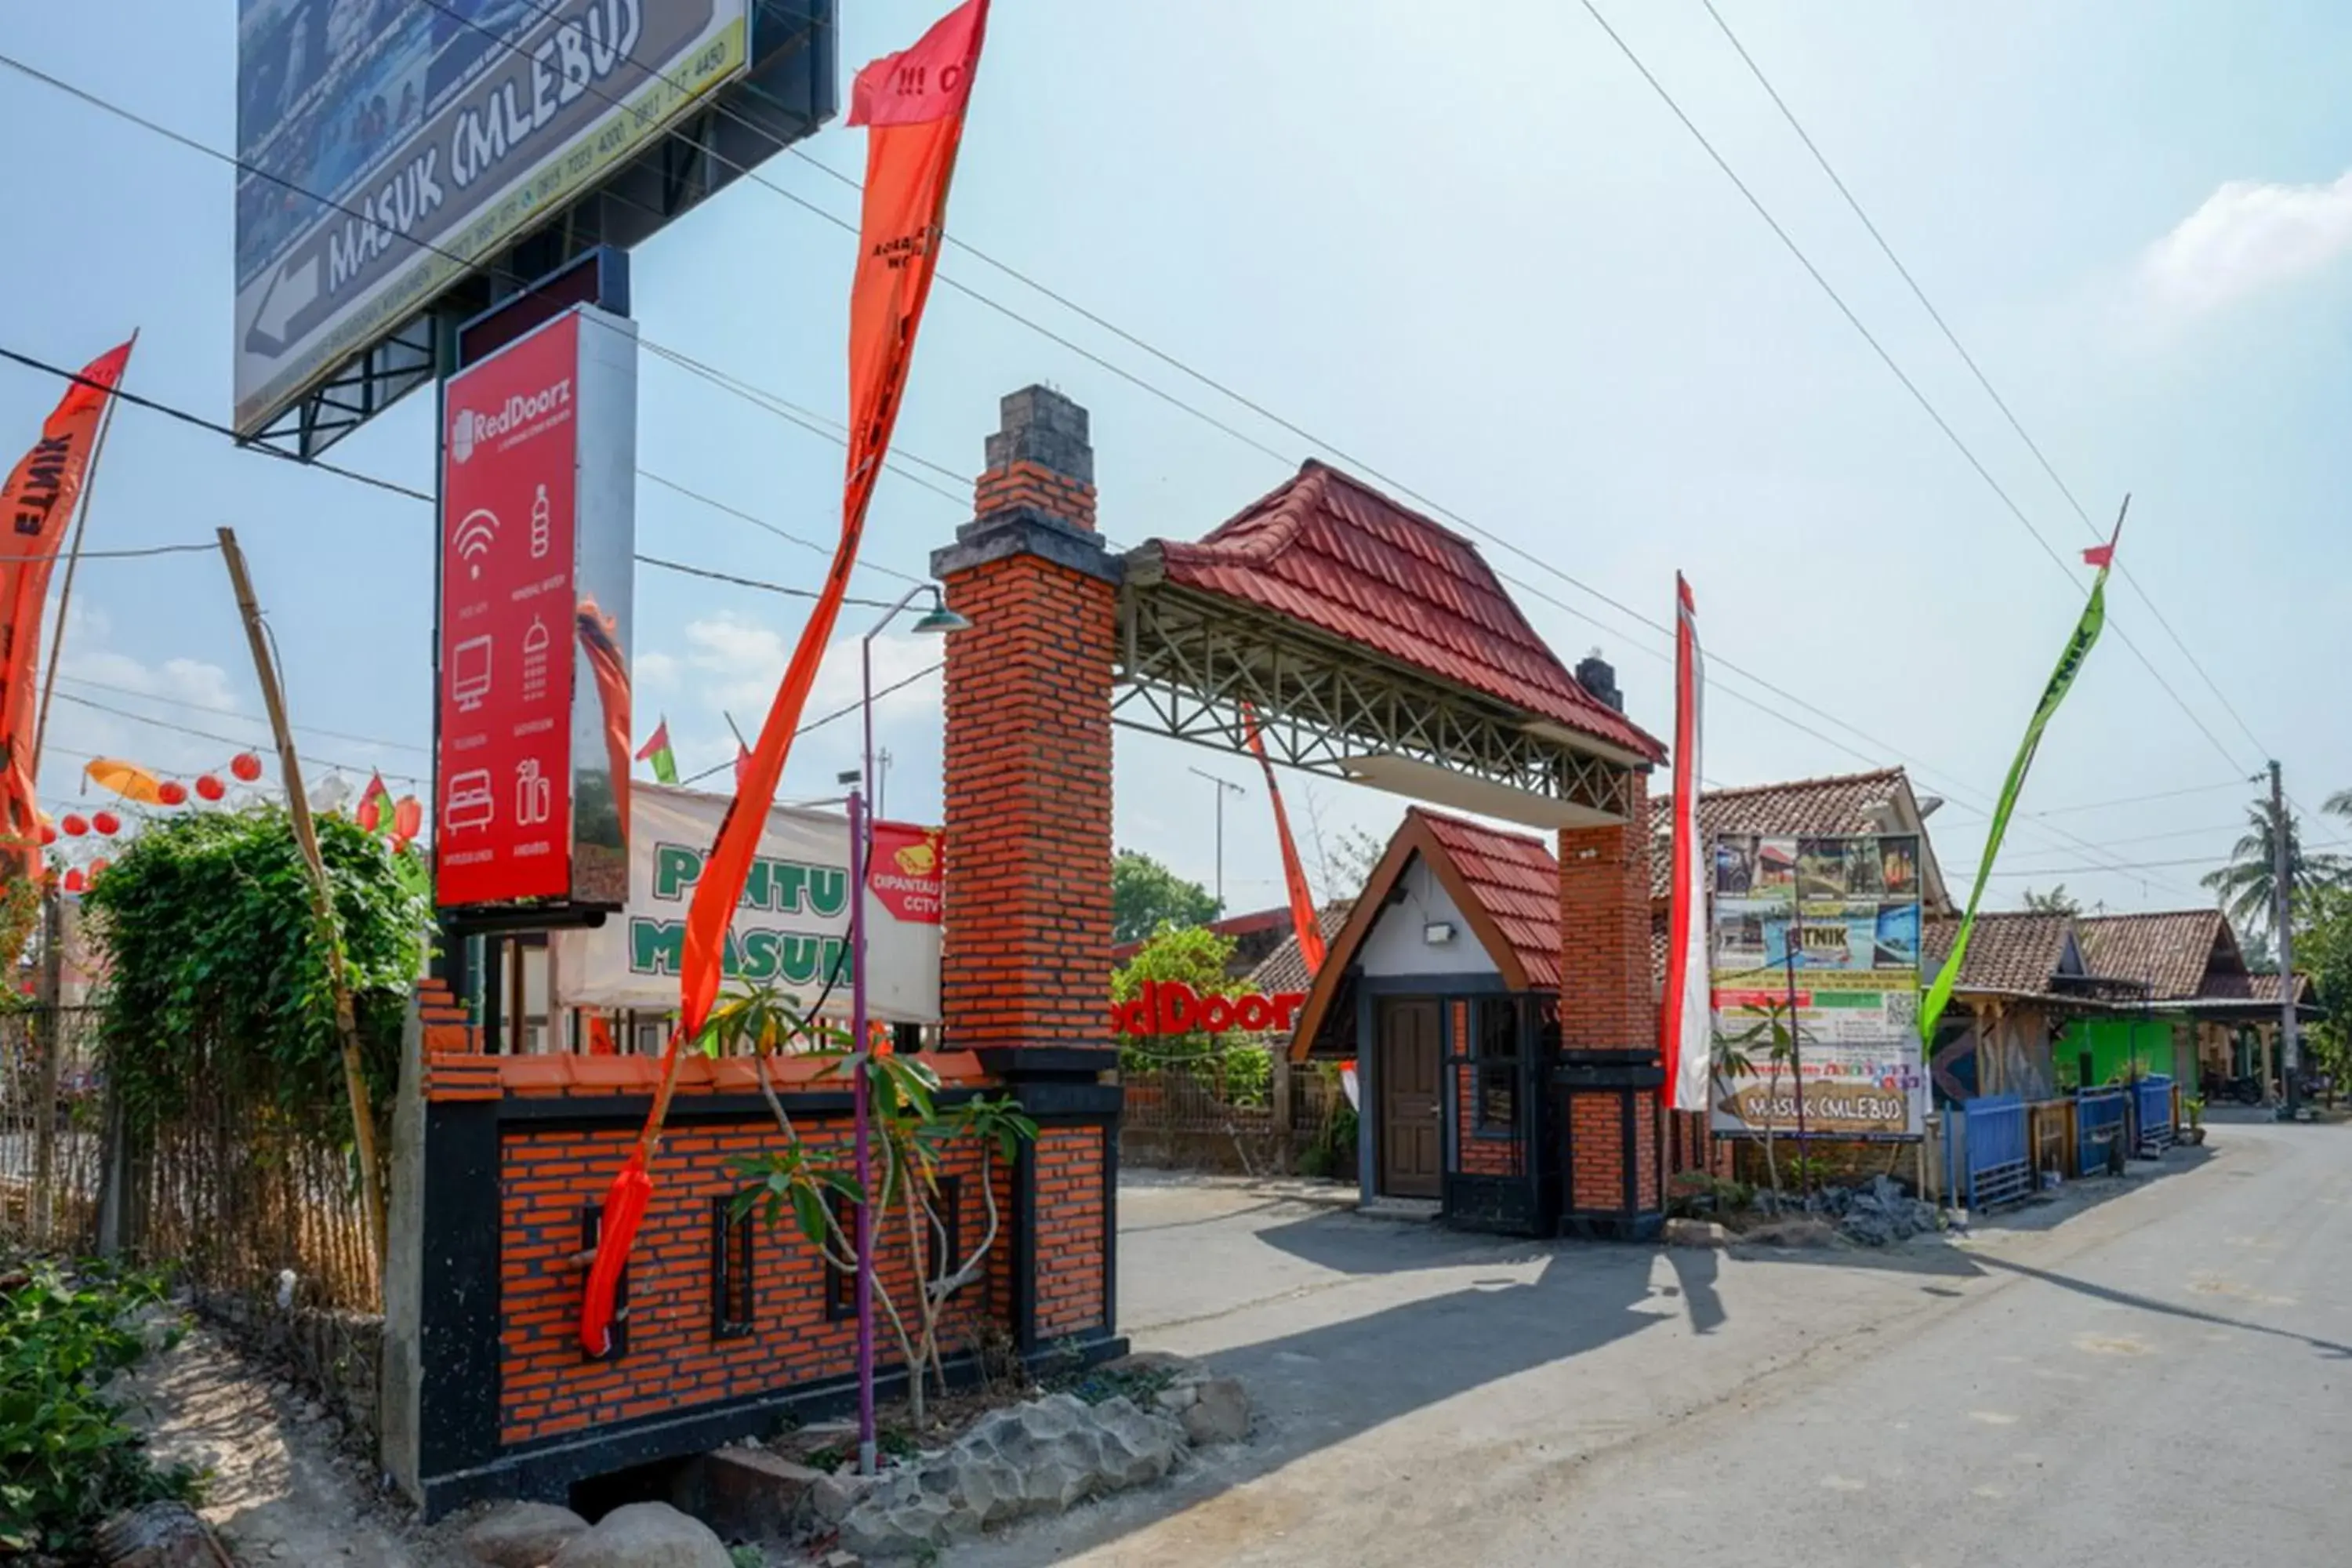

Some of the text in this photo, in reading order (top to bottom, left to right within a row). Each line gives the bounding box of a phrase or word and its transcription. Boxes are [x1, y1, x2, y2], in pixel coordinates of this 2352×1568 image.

[329, 147, 443, 293] MASUK
[452, 0, 641, 188] (MLEBU)
[474, 379, 571, 444] RedDoorz
[653, 841, 849, 916] PNTU
[903, 896, 939, 913] CCTV
[1798, 927, 1848, 947] TNIK
[1109, 975, 1307, 1037] dDoor
